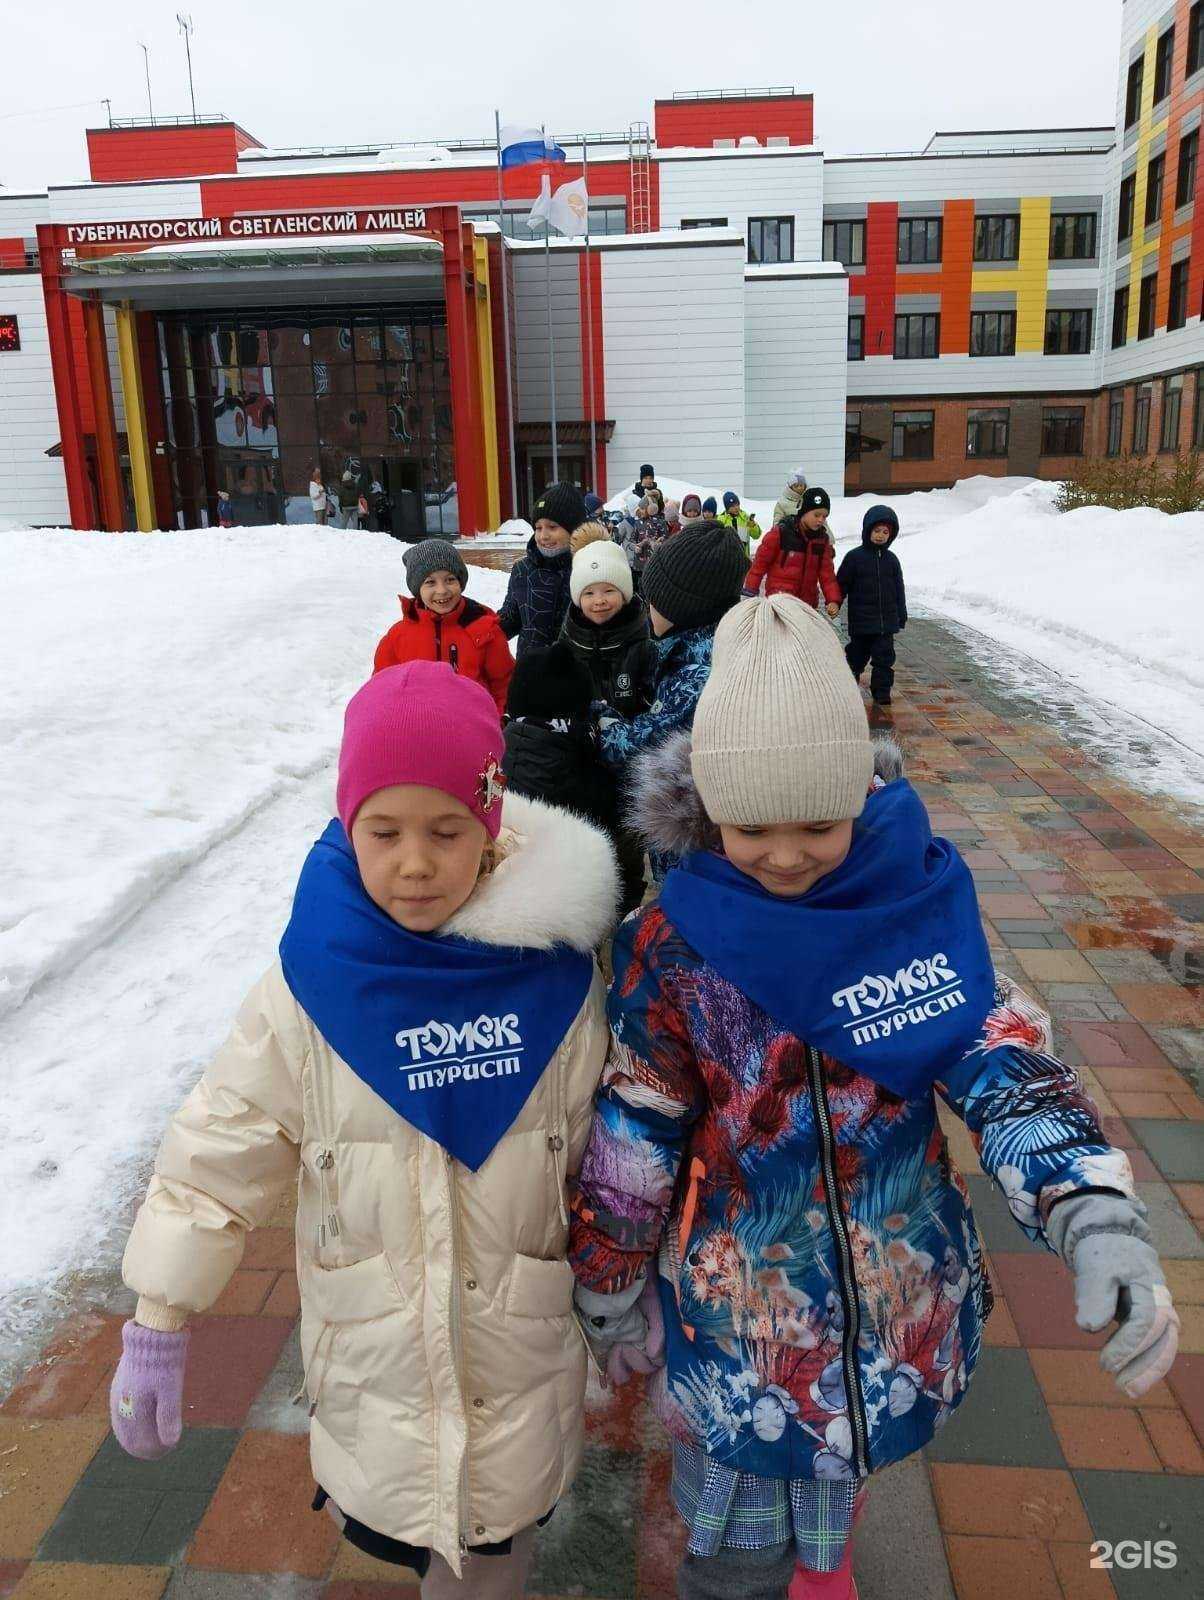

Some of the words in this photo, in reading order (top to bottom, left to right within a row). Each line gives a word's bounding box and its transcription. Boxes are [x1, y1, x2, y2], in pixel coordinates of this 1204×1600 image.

[67, 217, 222, 243] ГУБЕРНАТОРСКИЙ
[229, 211, 358, 236] СВЕТЛЕНСКИЙ
[364, 208, 427, 231] ЛИЦЕЙ
[832, 952, 958, 1017] ТОМСК
[395, 1013, 522, 1060] ТОМСК
[851, 989, 967, 1046] турист
[407, 1056, 521, 1091] турист
